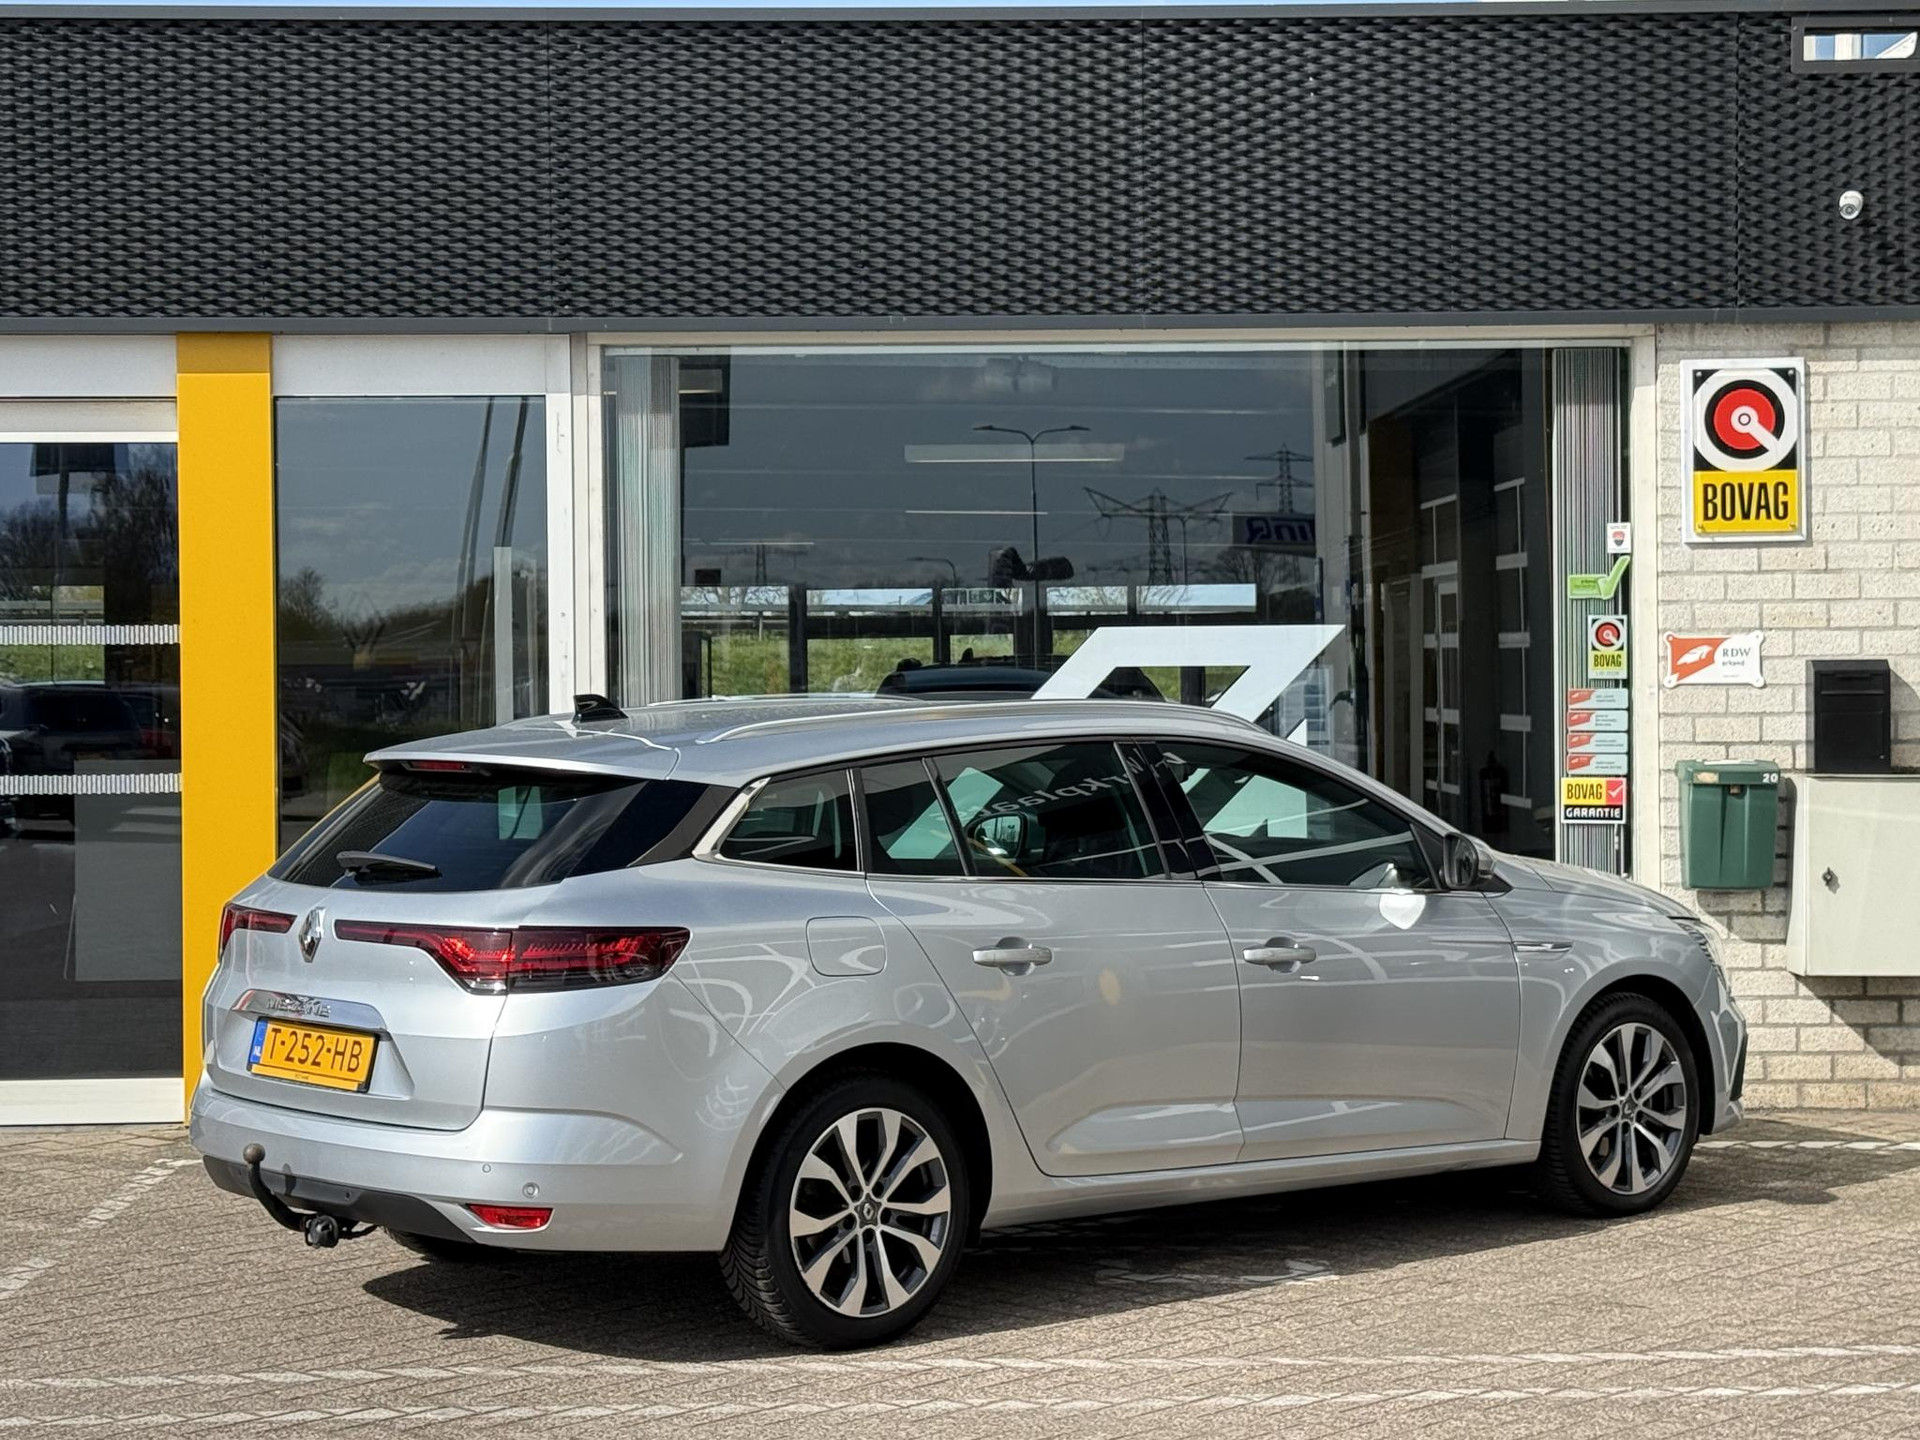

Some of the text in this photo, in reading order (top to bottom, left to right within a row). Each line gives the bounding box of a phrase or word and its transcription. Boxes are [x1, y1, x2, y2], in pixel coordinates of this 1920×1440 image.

[1702, 481, 1789, 522] BOVAG
[1722, 646, 1752, 658] RDW
[1593, 653, 1622, 668] BOVAG
[1762, 773, 1778, 784] 20
[1566, 782, 1603, 801] BOVAG
[1565, 806, 1622, 819] GARANTIE
[269, 1027, 363, 1073] T-252-HB
